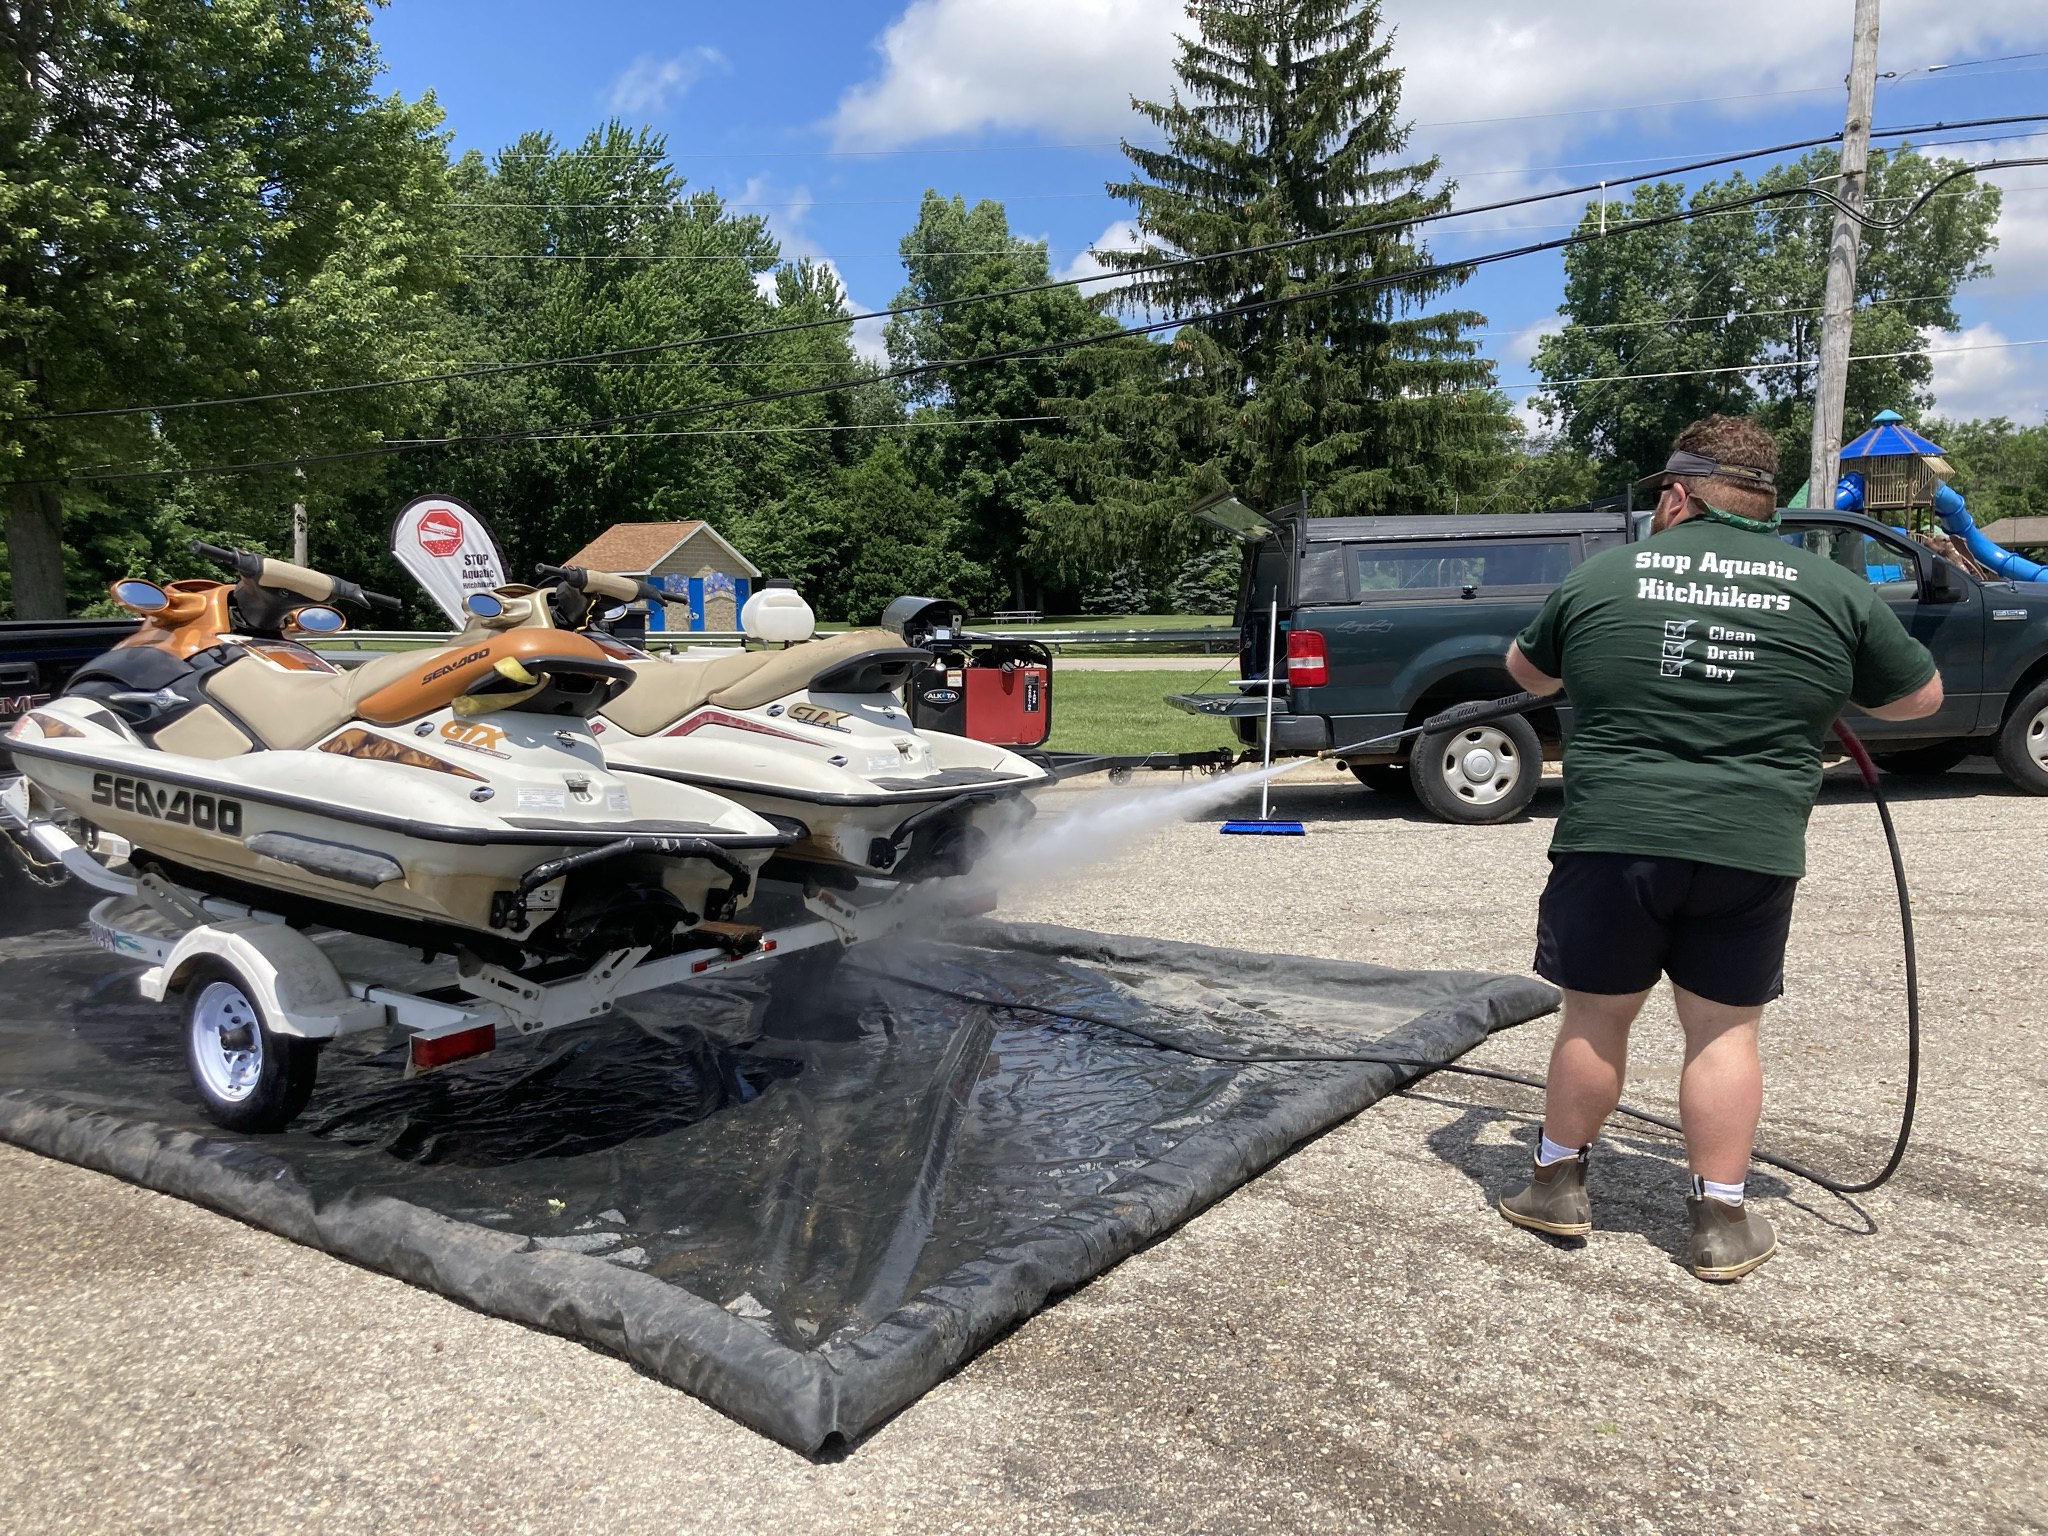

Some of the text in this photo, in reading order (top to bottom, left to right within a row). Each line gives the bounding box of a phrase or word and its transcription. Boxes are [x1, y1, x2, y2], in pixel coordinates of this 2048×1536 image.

[464, 553, 489, 566] STOP
[1635, 551, 1798, 581] Stop Aquatic
[462, 568, 495, 580] Aquatic
[1637, 577, 1791, 611] Hitchhikers
[1709, 626, 1756, 642] Clean
[1707, 645, 1755, 661] Drain
[1705, 664, 1735, 682] Dry
[0, 693, 51, 714] MC
[787, 702, 853, 728] GTX
[440, 720, 512, 750] GTX
